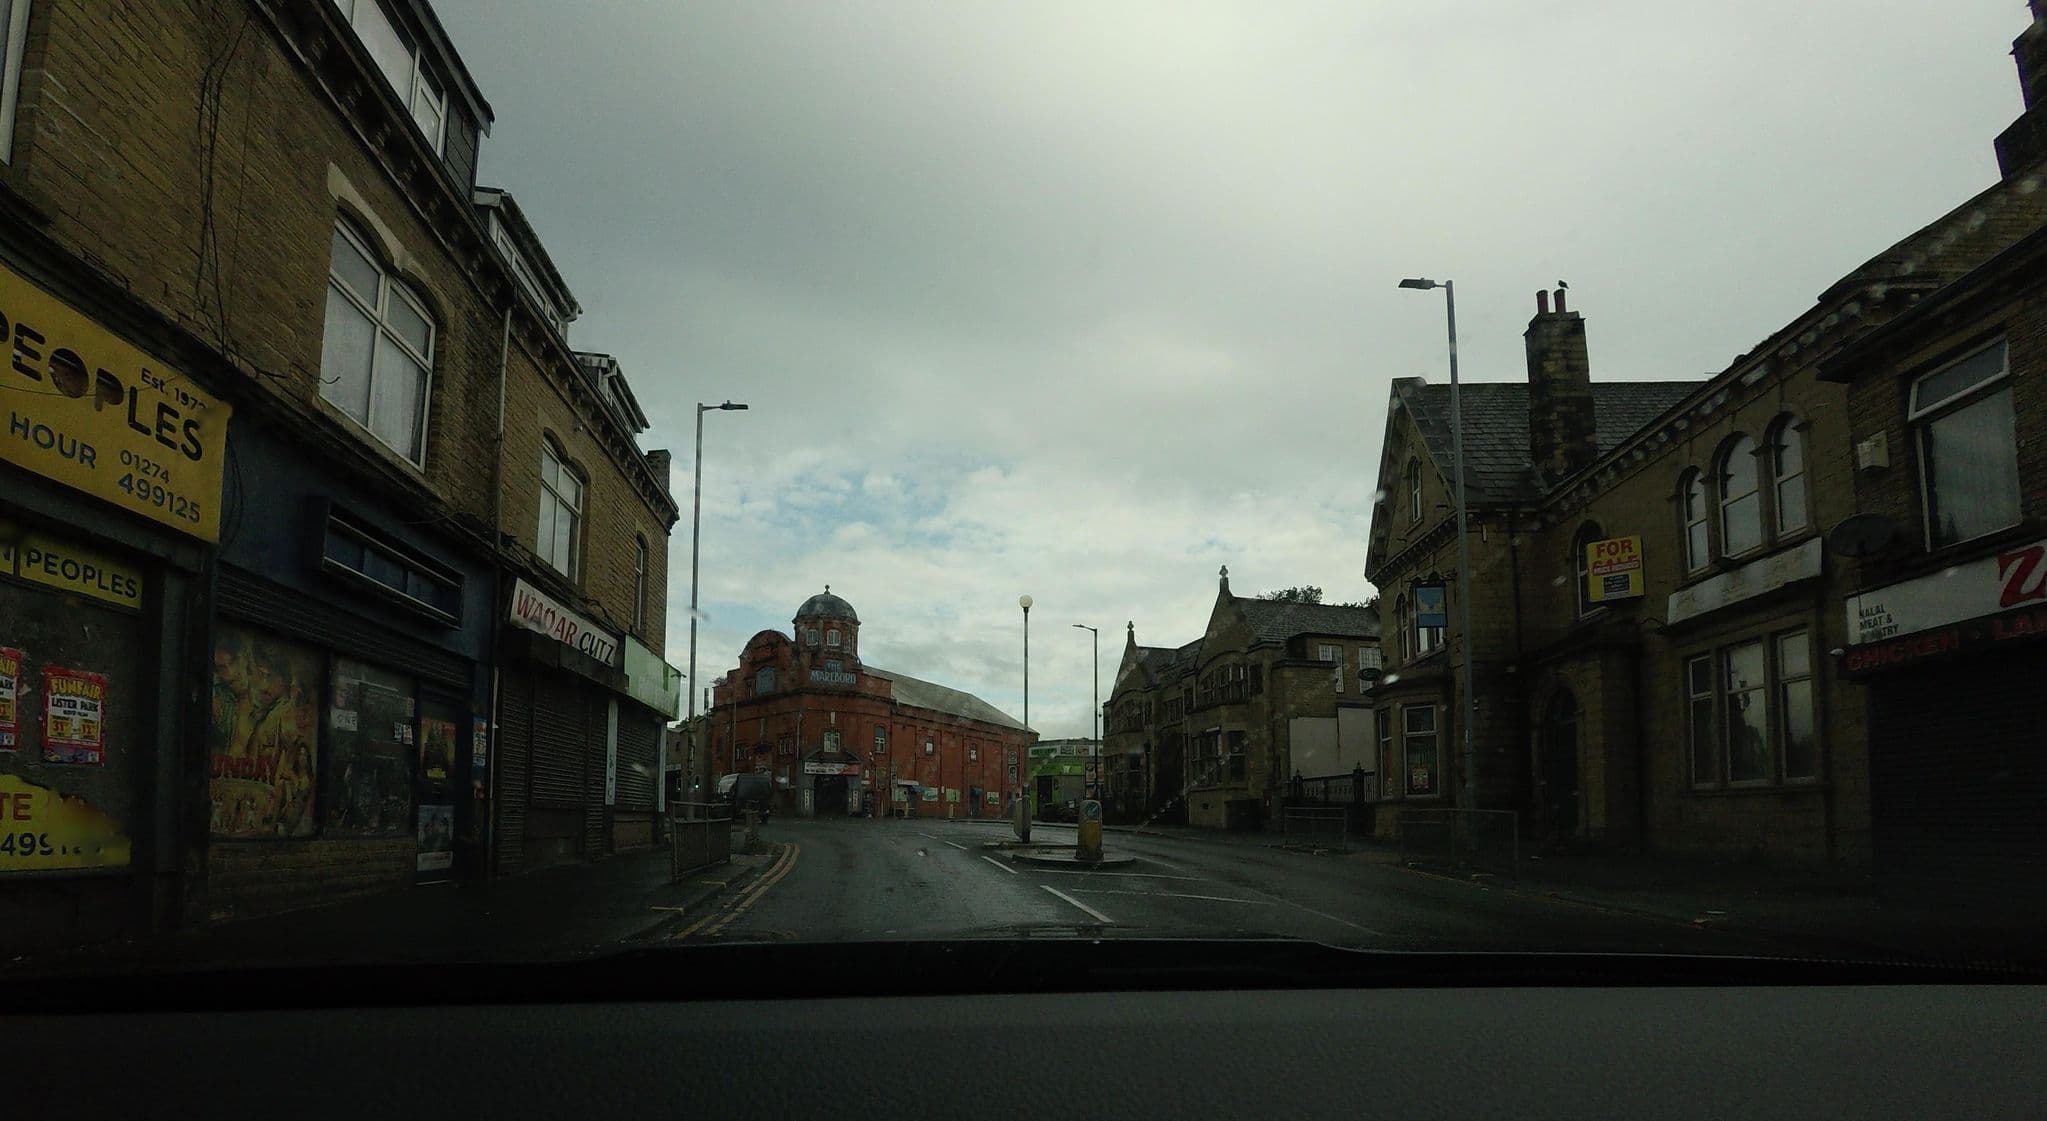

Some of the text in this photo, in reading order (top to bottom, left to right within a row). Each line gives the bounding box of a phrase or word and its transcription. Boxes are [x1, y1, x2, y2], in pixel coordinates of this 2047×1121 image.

[141, 368, 206, 409] Est. 197
[10, 411, 97, 469] HOUR
[119, 449, 170, 484] 01274
[118, 473, 201, 523] 499125
[1596, 539, 1633, 558] FOR
[26, 548, 138, 598] PEOPLES
[579, 631, 616, 665] CUTZ
